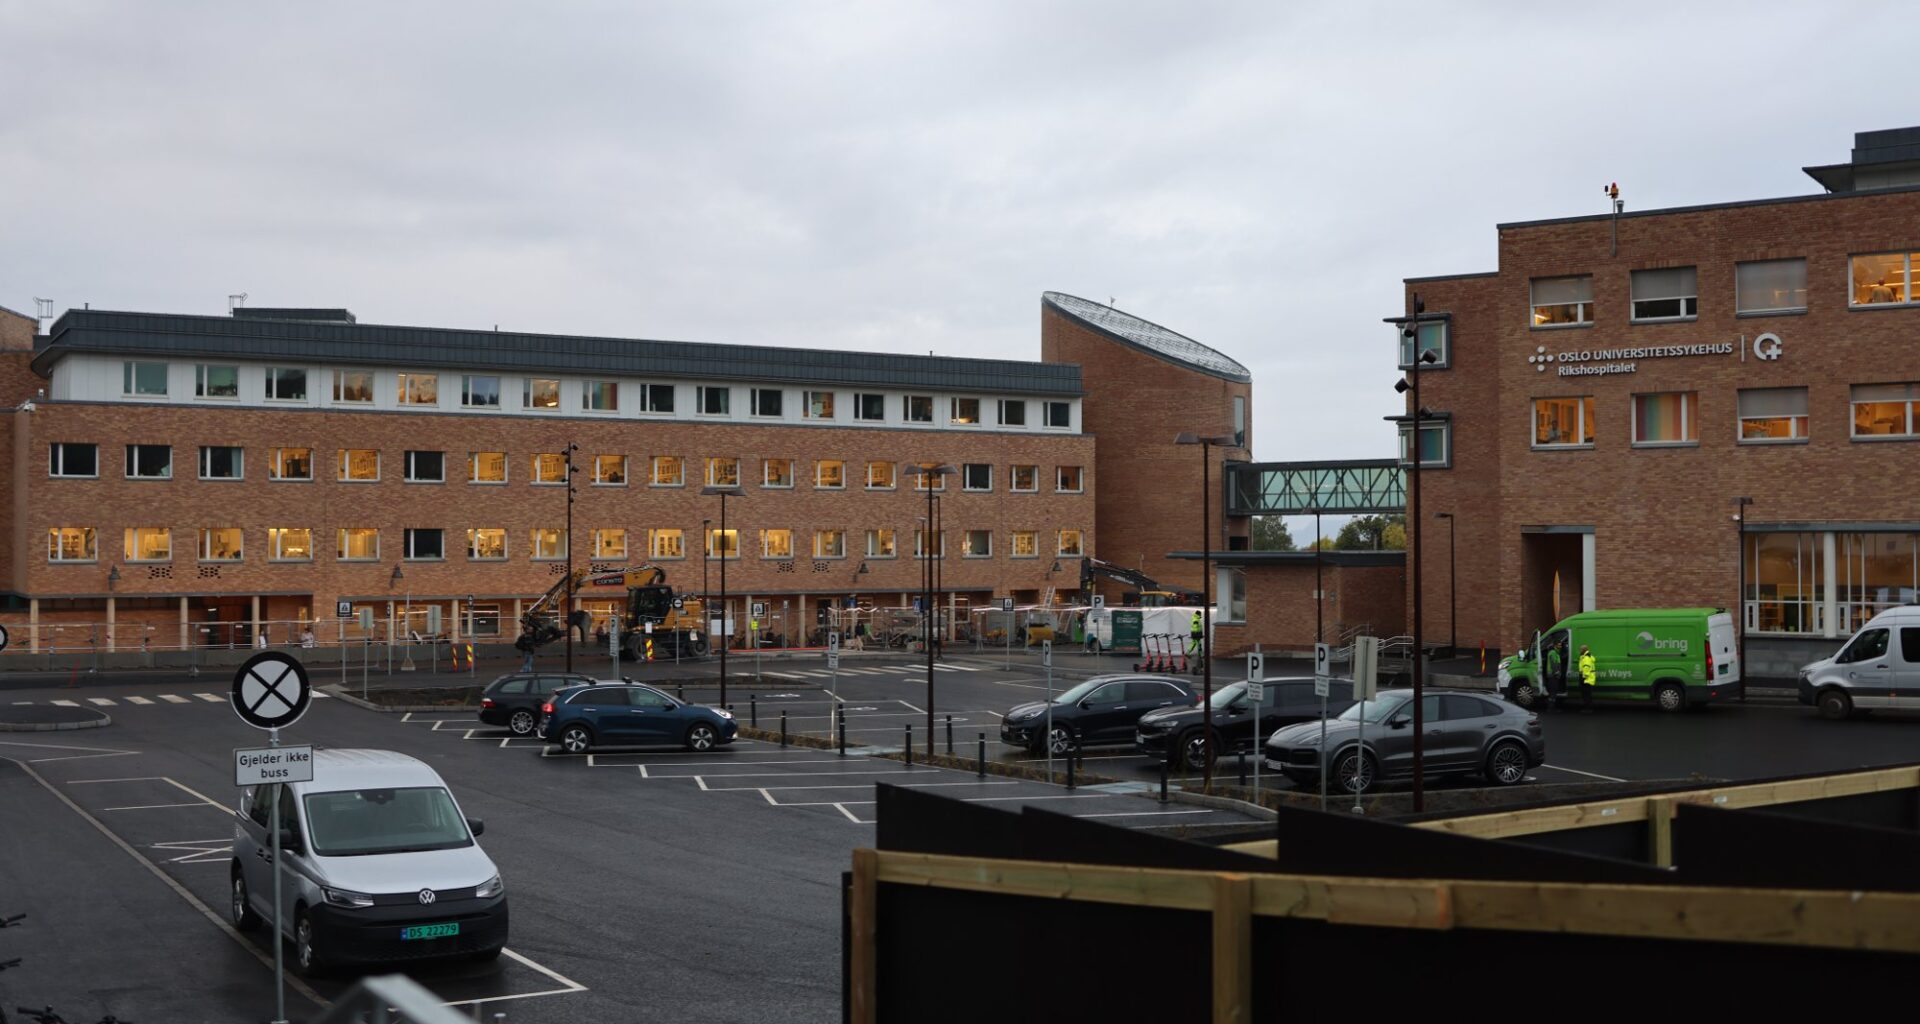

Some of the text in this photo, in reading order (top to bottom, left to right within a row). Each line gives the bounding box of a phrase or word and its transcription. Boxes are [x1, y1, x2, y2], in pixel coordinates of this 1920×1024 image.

[1558, 342, 1733, 363] OSLO UNIVERSITETSSYKEHUS
[1558, 363, 1636, 377] Rikshospitalet
[1094, 596, 1102, 608] P
[830, 634, 837, 651] P
[1654, 638, 1688, 651] bring
[1318, 647, 1326, 671] P
[1251, 656, 1260, 679] P
[1608, 669, 1632, 680] Ways
[239, 752, 309, 768] Gjelder ikke
[261, 768, 289, 778] buss
[409, 924, 457, 938] DS 22279
